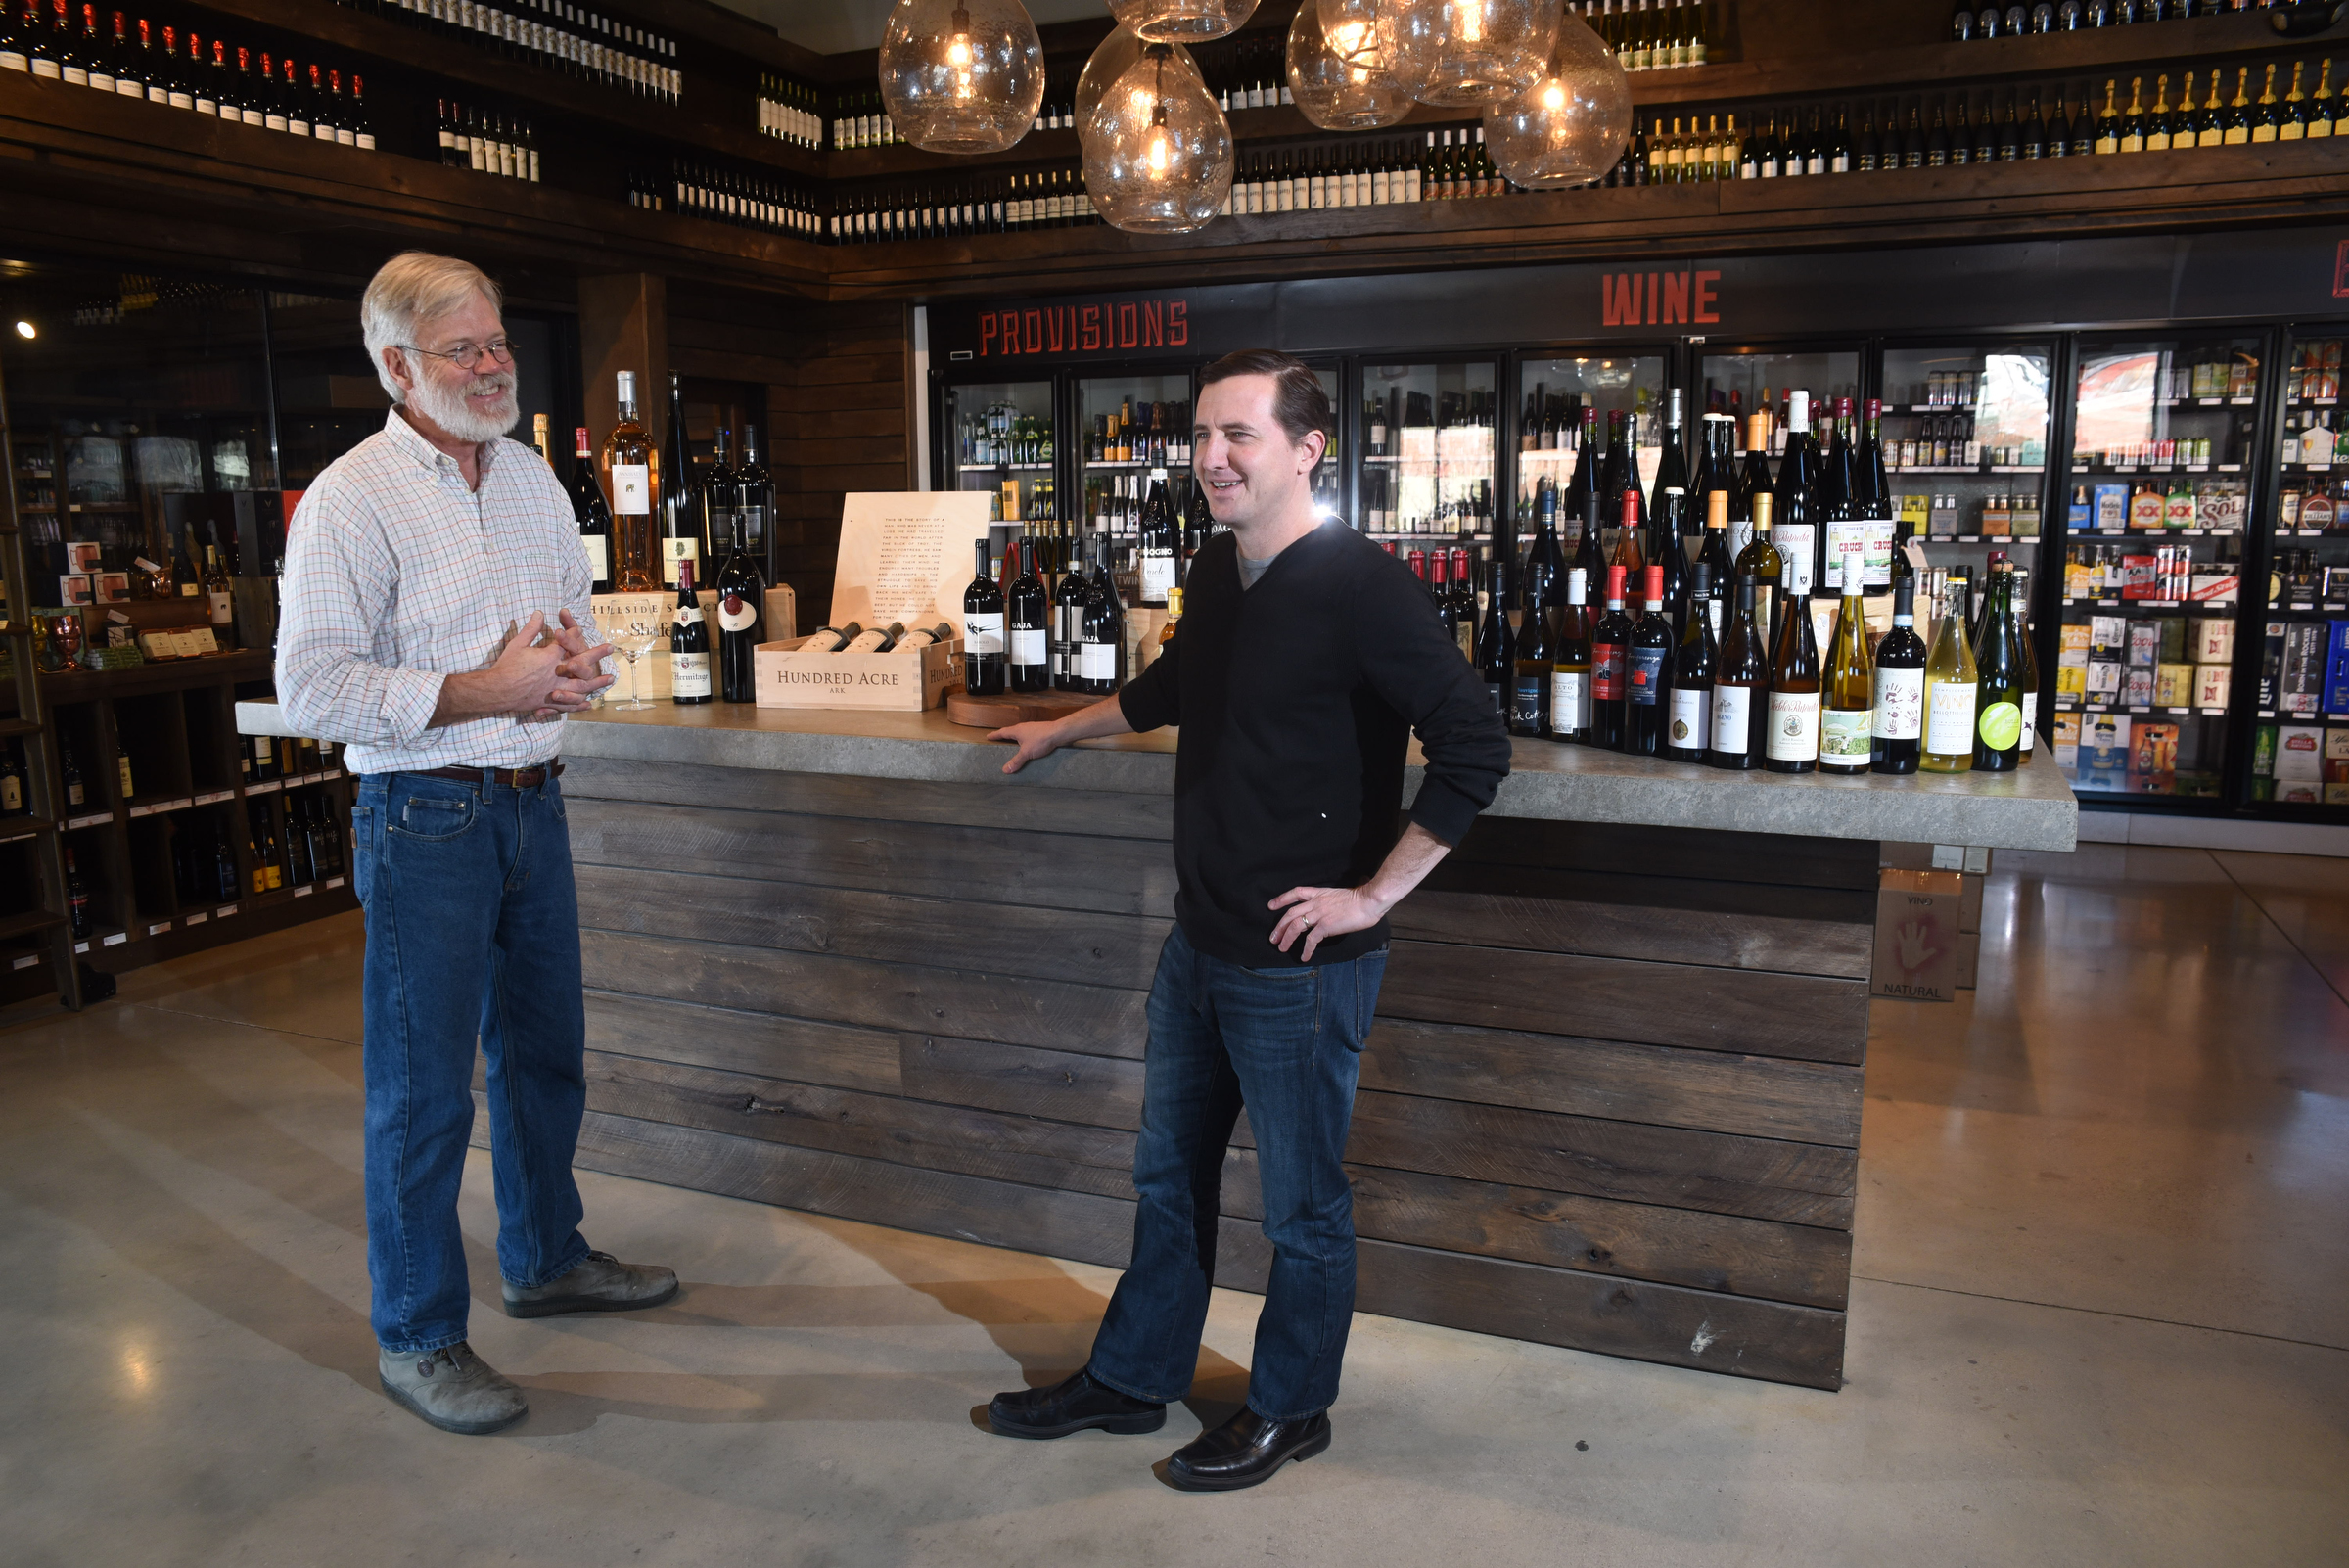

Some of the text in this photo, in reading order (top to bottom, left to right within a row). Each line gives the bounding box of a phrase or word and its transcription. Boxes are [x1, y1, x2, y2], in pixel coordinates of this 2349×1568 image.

[1601, 272, 1721, 328] WINE
[979, 299, 1188, 356] PROVISIONS
[2135, 506, 2161, 517] XX
[2168, 506, 2192, 517] XX
[591, 604, 658, 615] HILLSIDE
[629, 622, 673, 638] Shafe
[2301, 627, 2311, 656] ROCKIES
[671, 672, 709, 682] 'Hermitage
[777, 670, 898, 686] HUNDRED ACRE
[929, 665, 963, 684] HUNDRED
[1935, 694, 1973, 710] VINO
[1907, 896, 1933, 906] VINO
[1884, 983, 1941, 998] NATURAL
